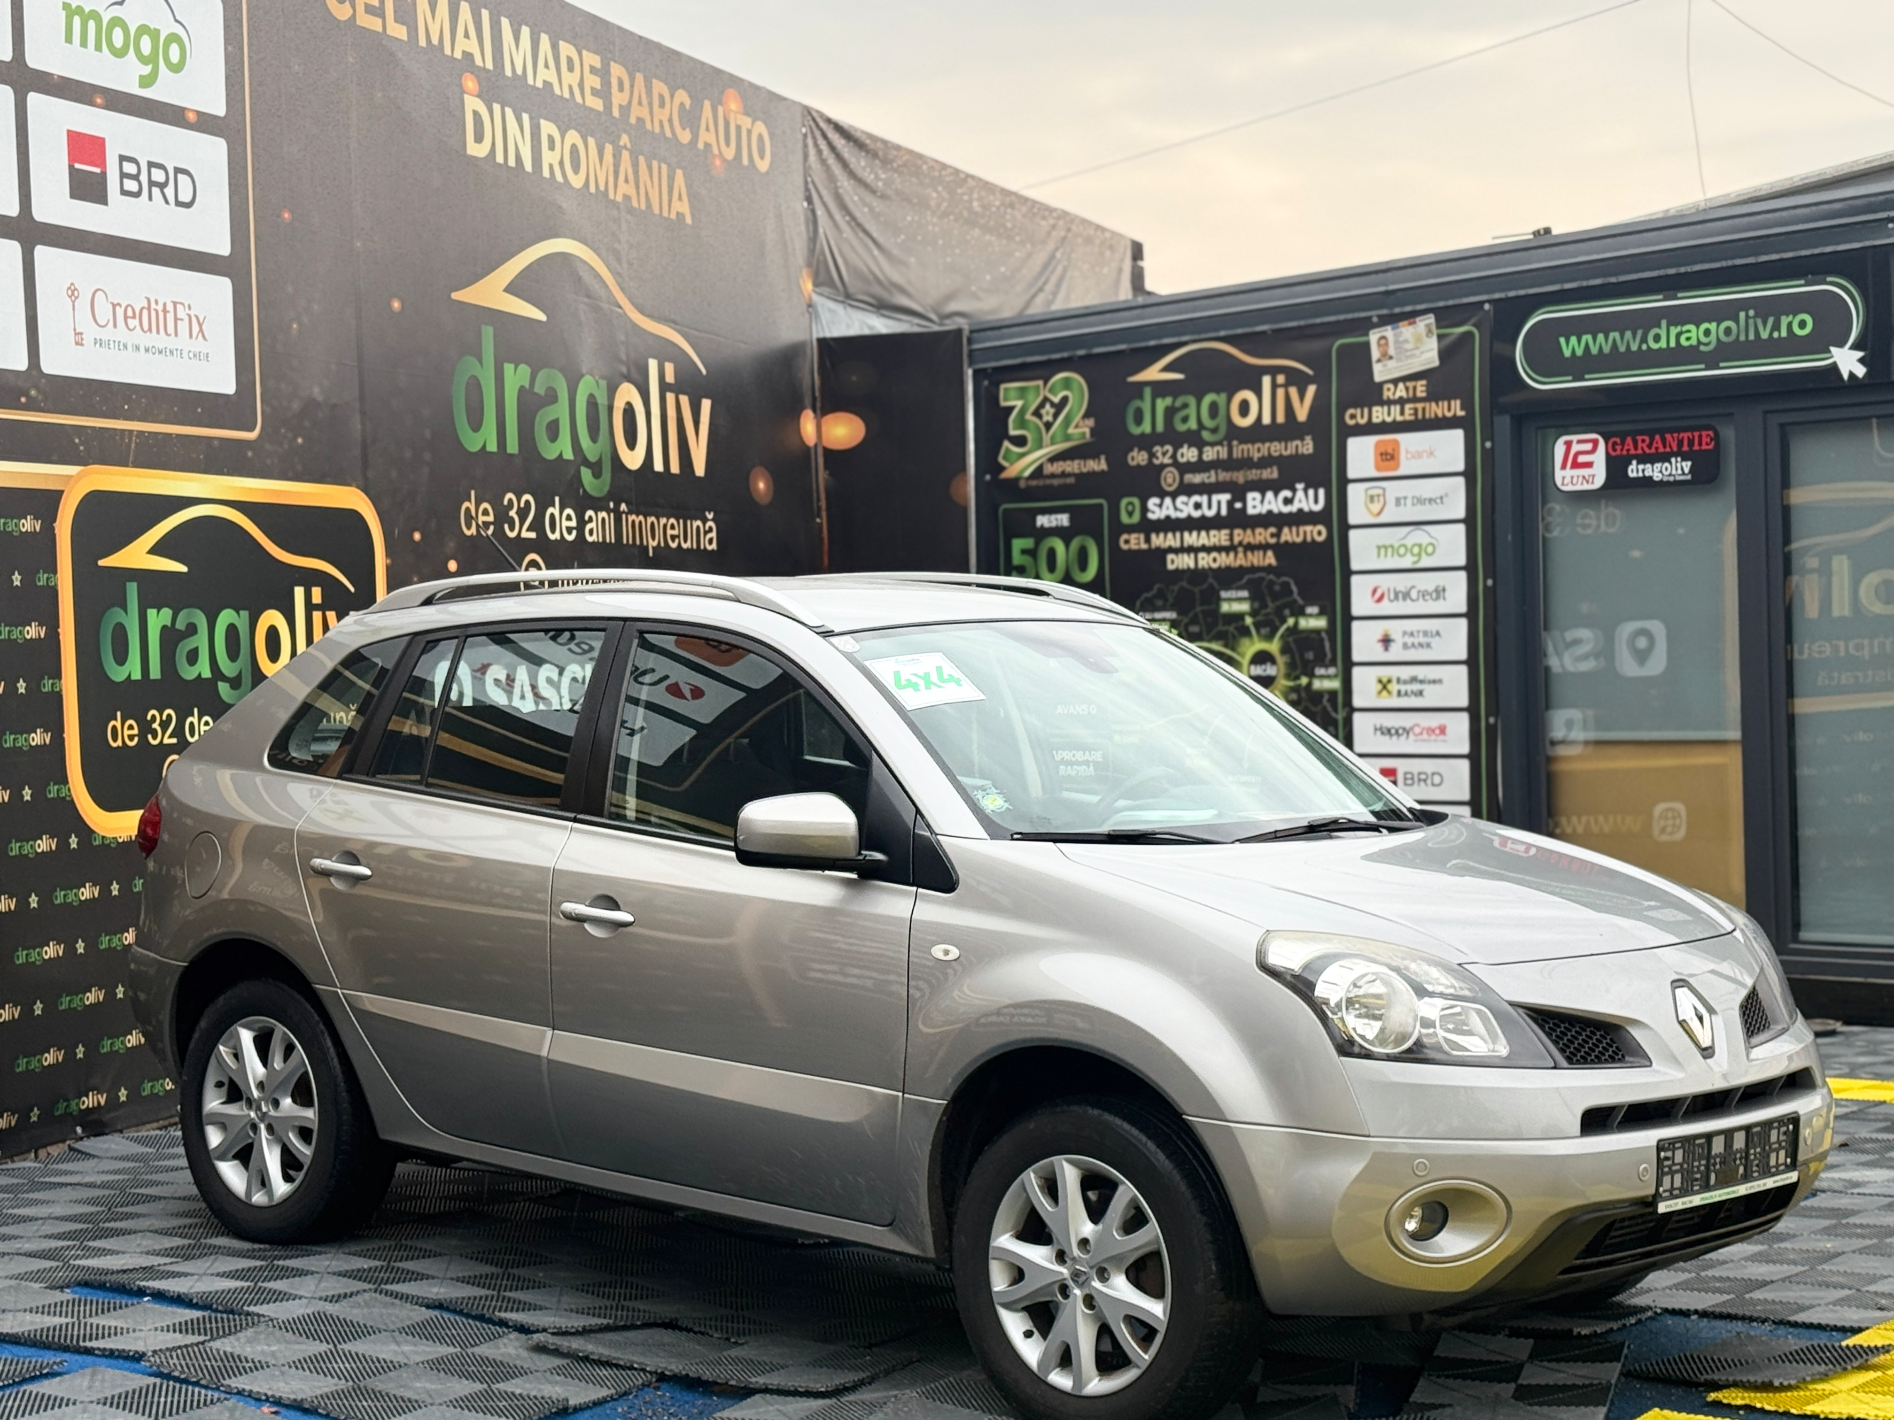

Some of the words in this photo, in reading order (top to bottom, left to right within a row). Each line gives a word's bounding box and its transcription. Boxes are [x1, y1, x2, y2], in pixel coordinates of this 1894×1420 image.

[62, 1, 188, 89] mogo
[416, 0, 494, 71] MAI
[501, 16, 603, 112] MARE
[610, 61, 692, 144] PARC
[697, 99, 771, 173] AUTO
[463, 93, 532, 173] DIN
[540, 118, 692, 225] ROMÂNIA
[118, 153, 197, 209] BRD
[89, 287, 208, 342] CreditFix
[1558, 309, 1813, 358] www.dragoliv.ro
[93, 338, 128, 352] PRIETEN
[131, 343, 141, 354] IN
[144, 345, 184, 359] MOMENTE
[187, 349, 211, 363] CHEIE
[1382, 380, 1427, 400] RATE
[452, 324, 711, 498] dragoliv
[1126, 374, 1317, 442] dragoliv
[1344, 407, 1369, 425] CU
[1371, 399, 1466, 423] BULETINUL
[1127, 448, 1149, 466] de
[1152, 445, 1173, 465] 32
[1177, 443, 1199, 462] de
[1202, 441, 1228, 461] ani
[1232, 435, 1313, 461] împreună
[1379, 449, 1396, 462] tbi
[1405, 446, 1436, 461] bank
[1560, 438, 1600, 470] 12
[1607, 430, 1715, 456] GARANTIE
[1561, 474, 1596, 487] LUNI
[1627, 456, 1692, 481] dragoliv
[1147, 494, 1231, 520] SASCUT
[1246, 483, 1325, 515] BACĂU
[1395, 496, 1409, 508] BT
[460, 489, 494, 537] de
[503, 492, 537, 539] 32
[545, 496, 577, 541] de
[584, 501, 616, 544] ani
[621, 502, 717, 557] împreună
[1036, 513, 1070, 529] PESTE
[1119, 532, 1149, 550] CEL
[1151, 530, 1182, 549] MAI
[1184, 528, 1230, 547] MARE
[1233, 527, 1277, 545] PARC
[1280, 524, 1327, 543] AUTO
[1011, 535, 1099, 583] 500
[1166, 553, 1198, 570] DIN
[1199, 549, 1277, 570] ROMÂNIA
[1376, 541, 1437, 565] mogo
[1387, 586, 1447, 602] UniCredit
[1402, 630, 1441, 639] PATRIA
[1402, 641, 1433, 650] BANK
[1396, 676, 1443, 686] Raiffeisen
[1396, 688, 1425, 698] BANK
[2, 728, 52, 751] dragoliv
[107, 711, 139, 748] de
[147, 708, 178, 746] 32
[1374, 724, 1447, 740] HappyCredit
[1403, 771, 1444, 787] BRD
[8, 835, 57, 858] dragoliv
[53, 882, 100, 906] dragoliv
[14, 940, 65, 965] dragoliv
[58, 986, 106, 1011] dragoliv
[15, 1047, 65, 1072] dragoliv
[54, 1090, 107, 1116] dragoliv
